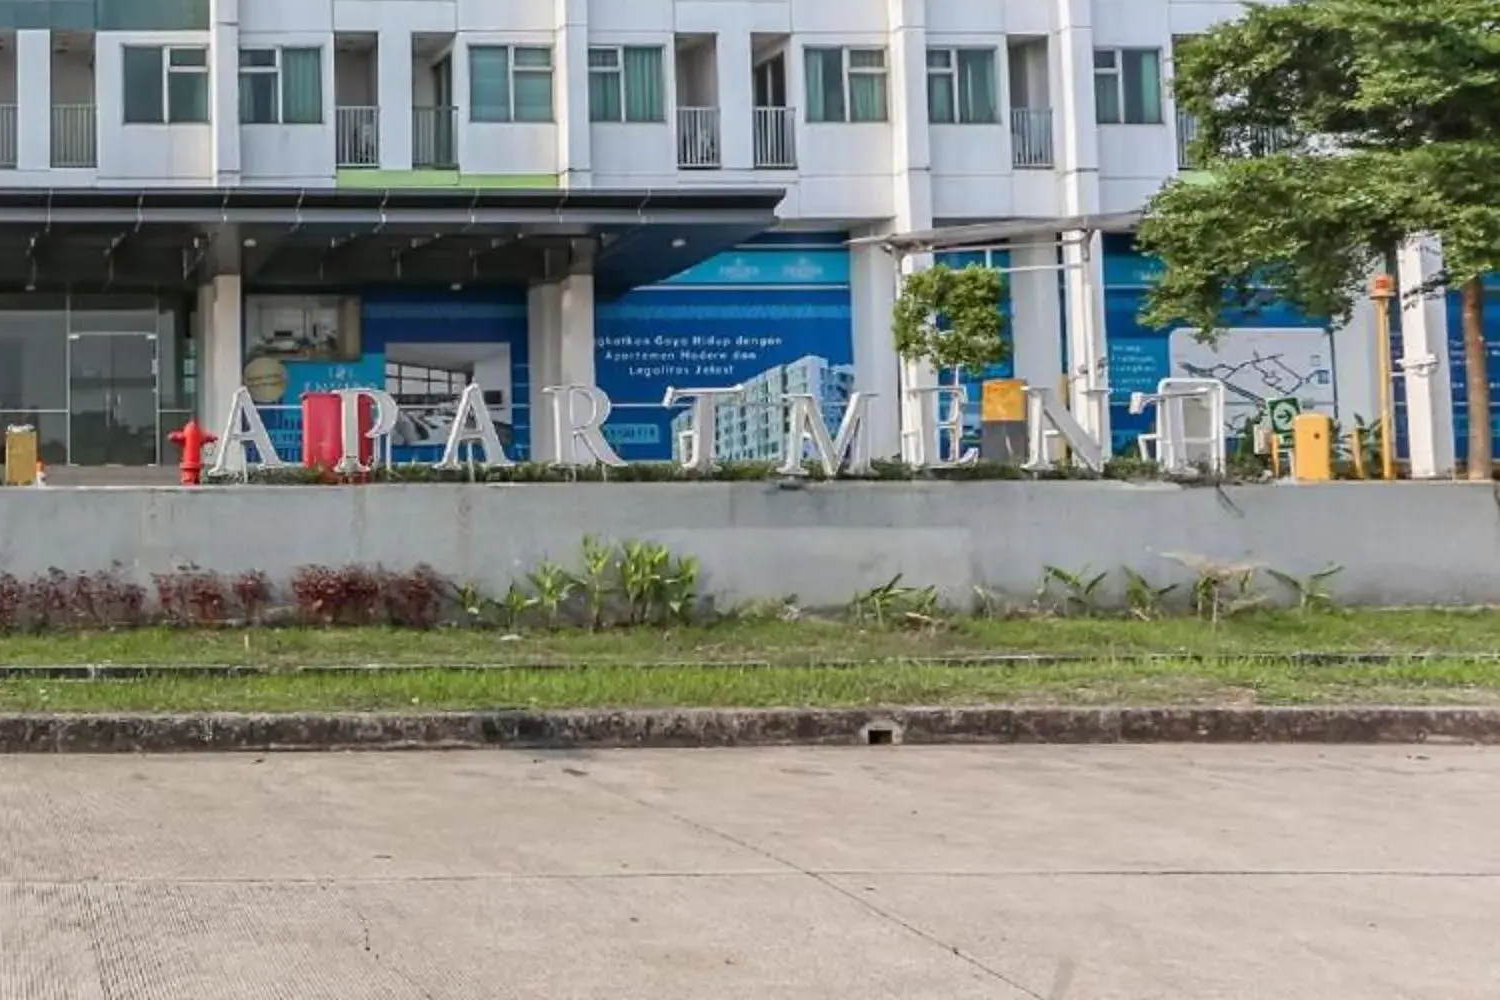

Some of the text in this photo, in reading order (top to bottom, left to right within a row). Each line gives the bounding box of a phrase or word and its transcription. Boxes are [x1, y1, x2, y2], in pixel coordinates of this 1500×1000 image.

[654, 335, 689, 347] Gaya
[692, 335, 731, 347] Hidup
[735, 335, 782, 347] dengan
[604, 351, 675, 361] Apartemen
[628, 365, 690, 377] Legalitas
[206, 382, 1222, 477] APARTMENT
